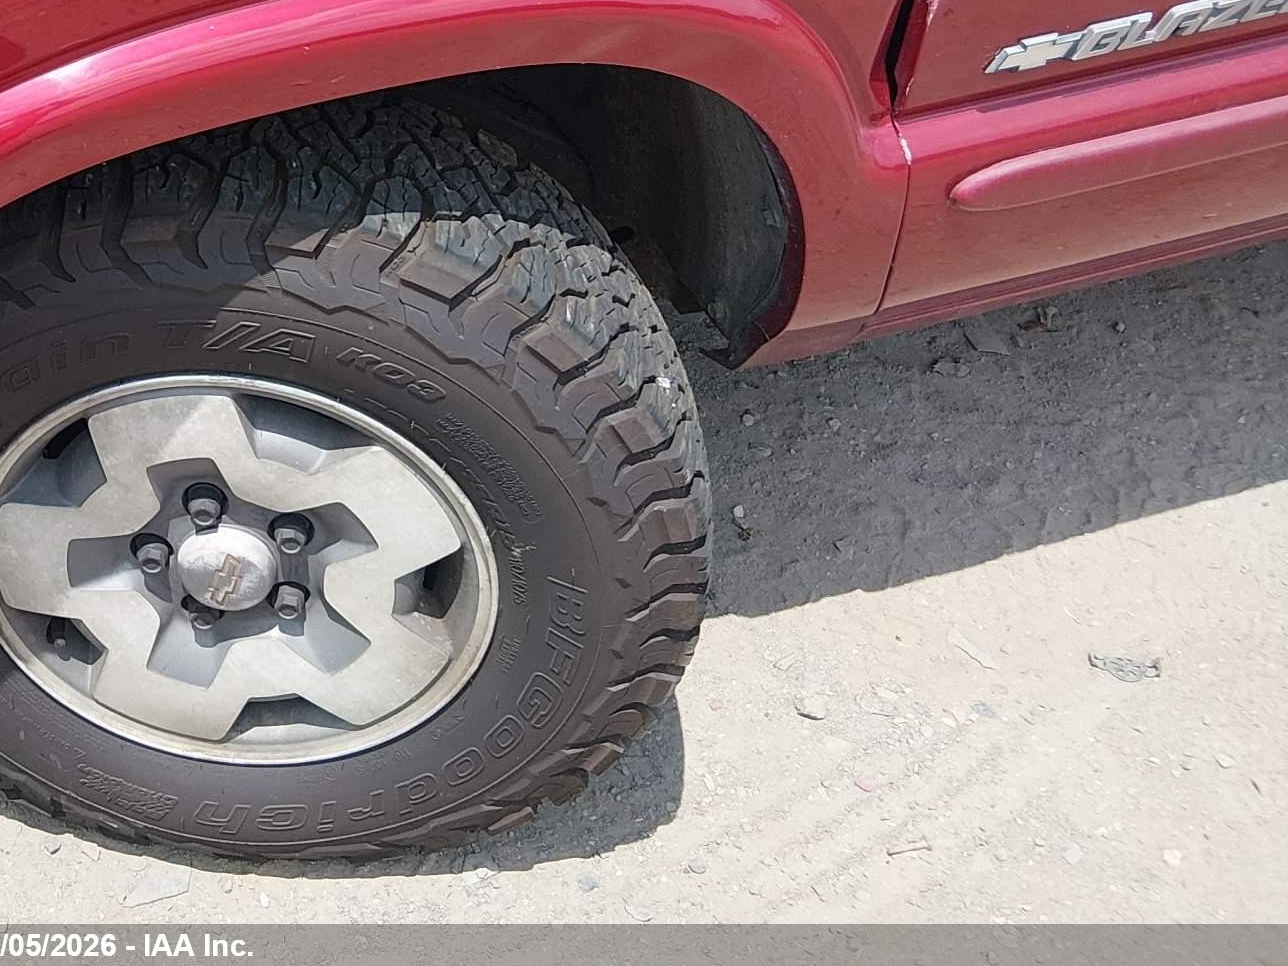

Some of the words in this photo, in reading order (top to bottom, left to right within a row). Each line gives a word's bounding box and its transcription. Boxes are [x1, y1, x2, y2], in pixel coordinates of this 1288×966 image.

[157, 320, 316, 363] T/A
[335, 346, 447, 403] KO3
[192, 575, 589, 836] BFGoodrich
